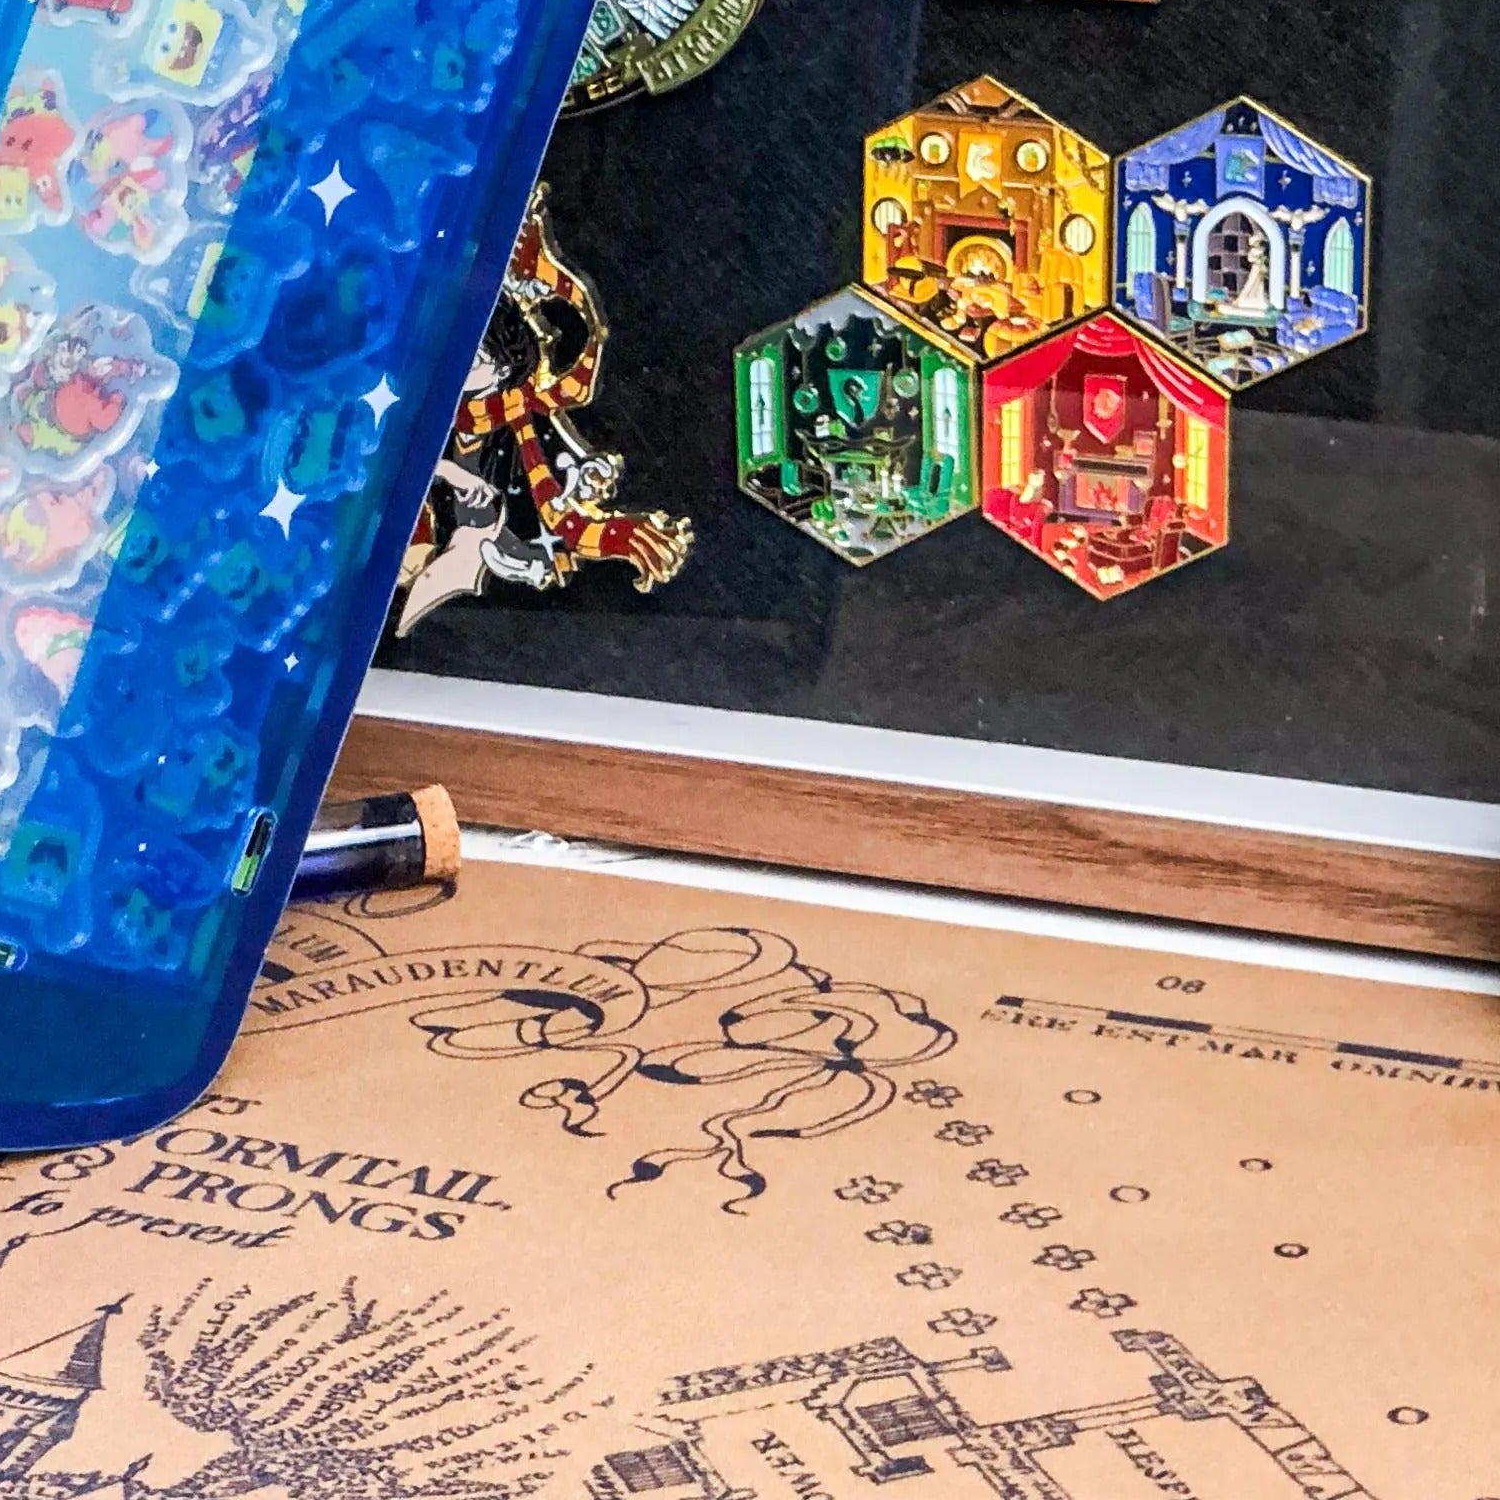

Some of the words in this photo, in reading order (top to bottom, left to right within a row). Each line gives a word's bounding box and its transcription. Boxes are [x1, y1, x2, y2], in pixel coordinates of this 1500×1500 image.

[251, 959, 634, 1017] MARAUDENTLUM
[123, 1160, 467, 1243] PRONGS
[124, 1126, 513, 1212] ORMTAIL,
[86, 1204, 297, 1250] present
